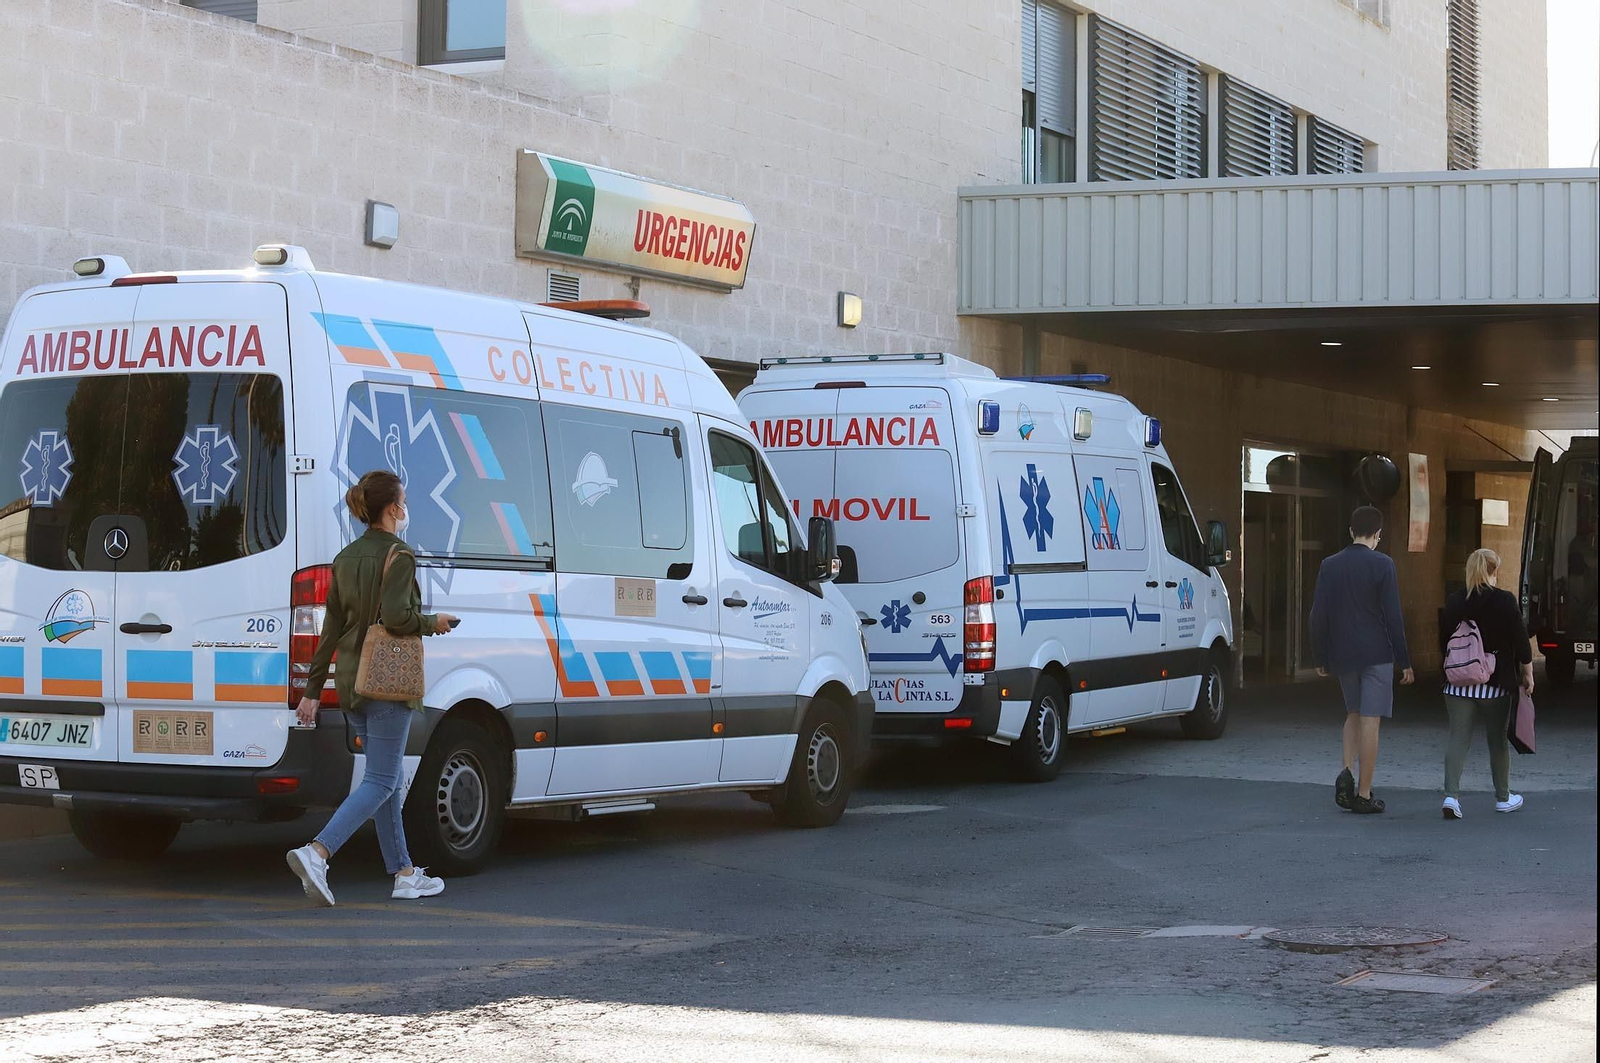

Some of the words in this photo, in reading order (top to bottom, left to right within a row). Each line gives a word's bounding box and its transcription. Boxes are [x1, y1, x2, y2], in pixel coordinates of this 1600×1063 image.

[634, 209, 746, 272] URGENCIAS
[17, 324, 266, 375] AMBULANCIA
[487, 345, 669, 407] COLECTIVA
[813, 498, 931, 521] MOVIL
[246, 618, 275, 633] 206
[820, 615, 832, 626] 206
[931, 614, 951, 624] 563
[1576, 643, 1592, 652] SP
[878, 691, 892, 701] LA
[894, 678, 932, 703] CINTA
[935, 691, 954, 701] S.L.
[11, 721, 52, 742] 6407
[57, 724, 89, 744] JNZ
[223, 750, 245, 758] GAZA
[24, 768, 53, 788] SP
